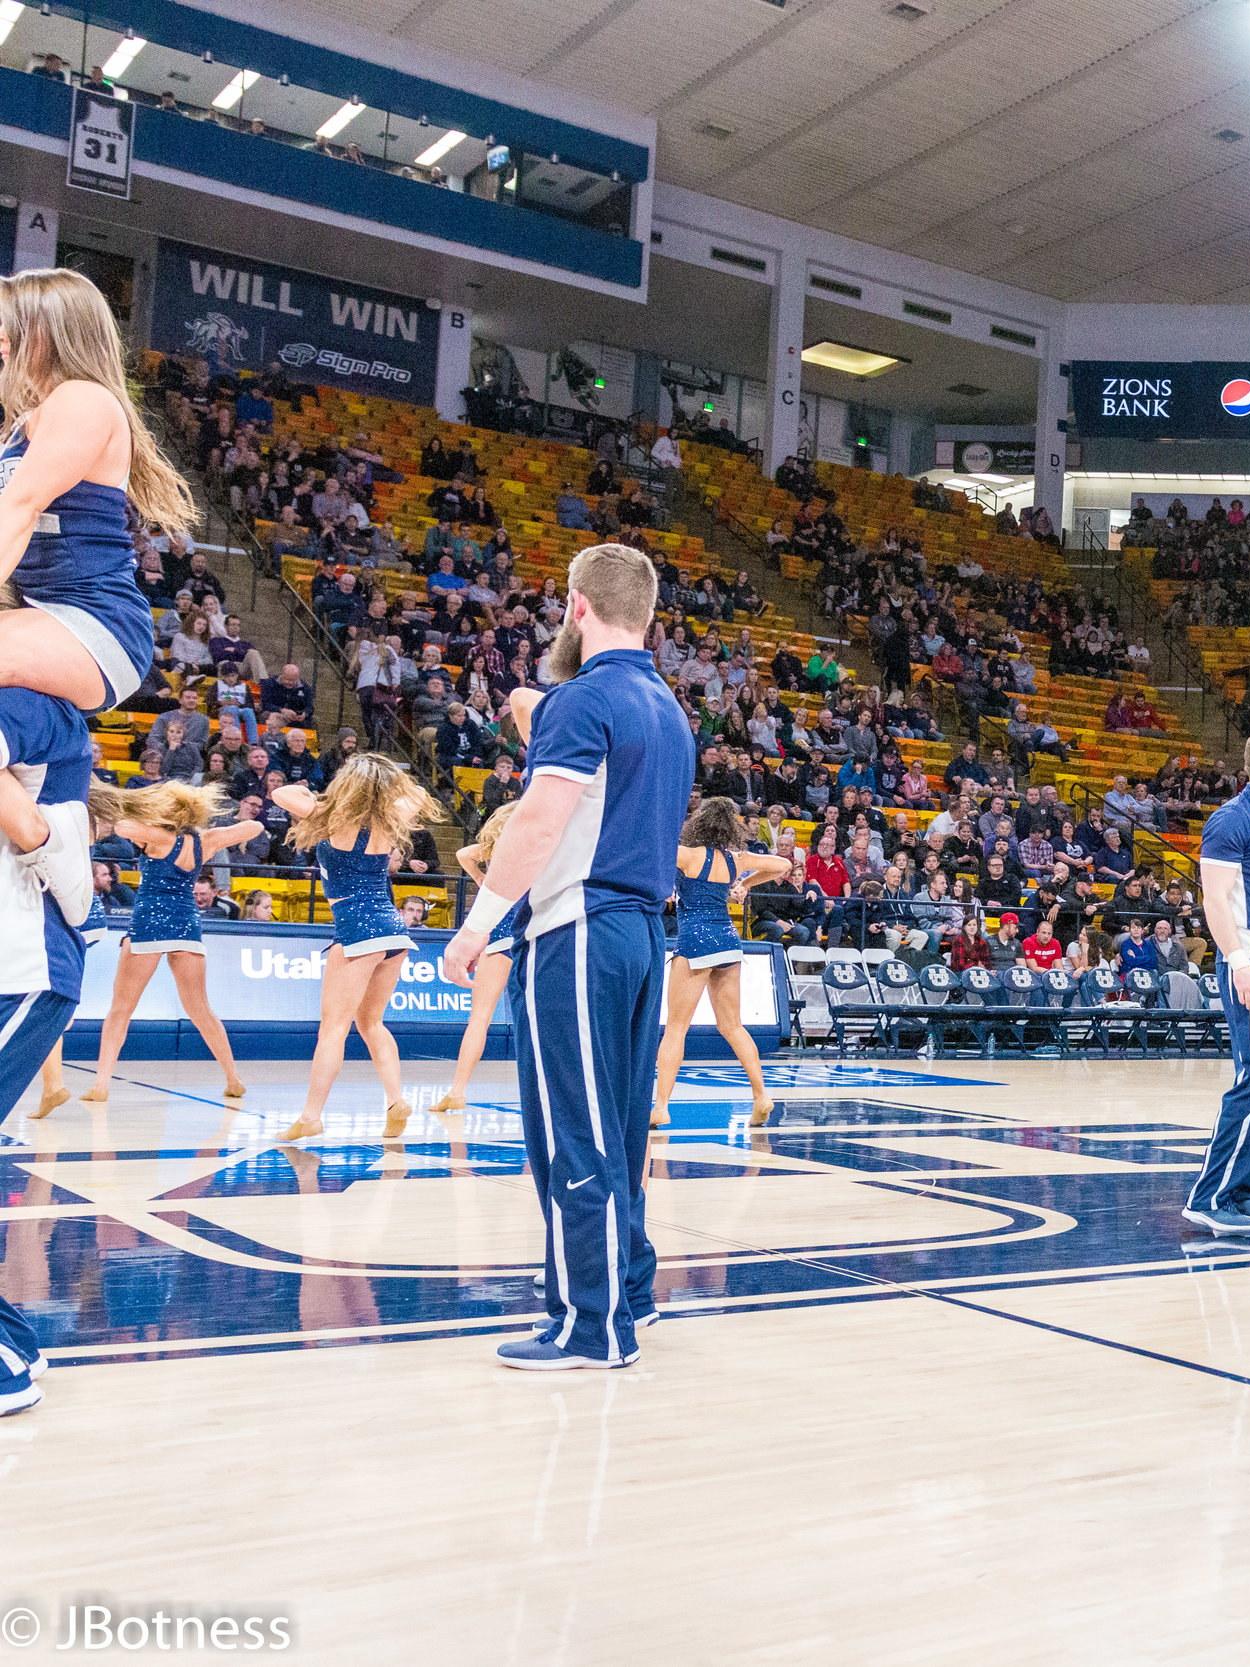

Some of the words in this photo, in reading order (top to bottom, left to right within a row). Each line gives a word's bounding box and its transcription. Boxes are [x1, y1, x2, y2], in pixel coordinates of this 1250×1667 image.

[84, 137, 117, 164] 31
[29, 212, 47, 232] A
[189, 260, 303, 317] WILL
[330, 292, 419, 342] WIN
[450, 312, 465, 329] B
[316, 350, 369, 375] Sign
[370, 361, 411, 383] Pro
[782, 389, 795, 406] C
[1102, 378, 1172, 397] ZIONS
[1102, 398, 1171, 418] BANK
[1050, 454, 1060, 467] D
[390, 991, 472, 1011] ONLINE
